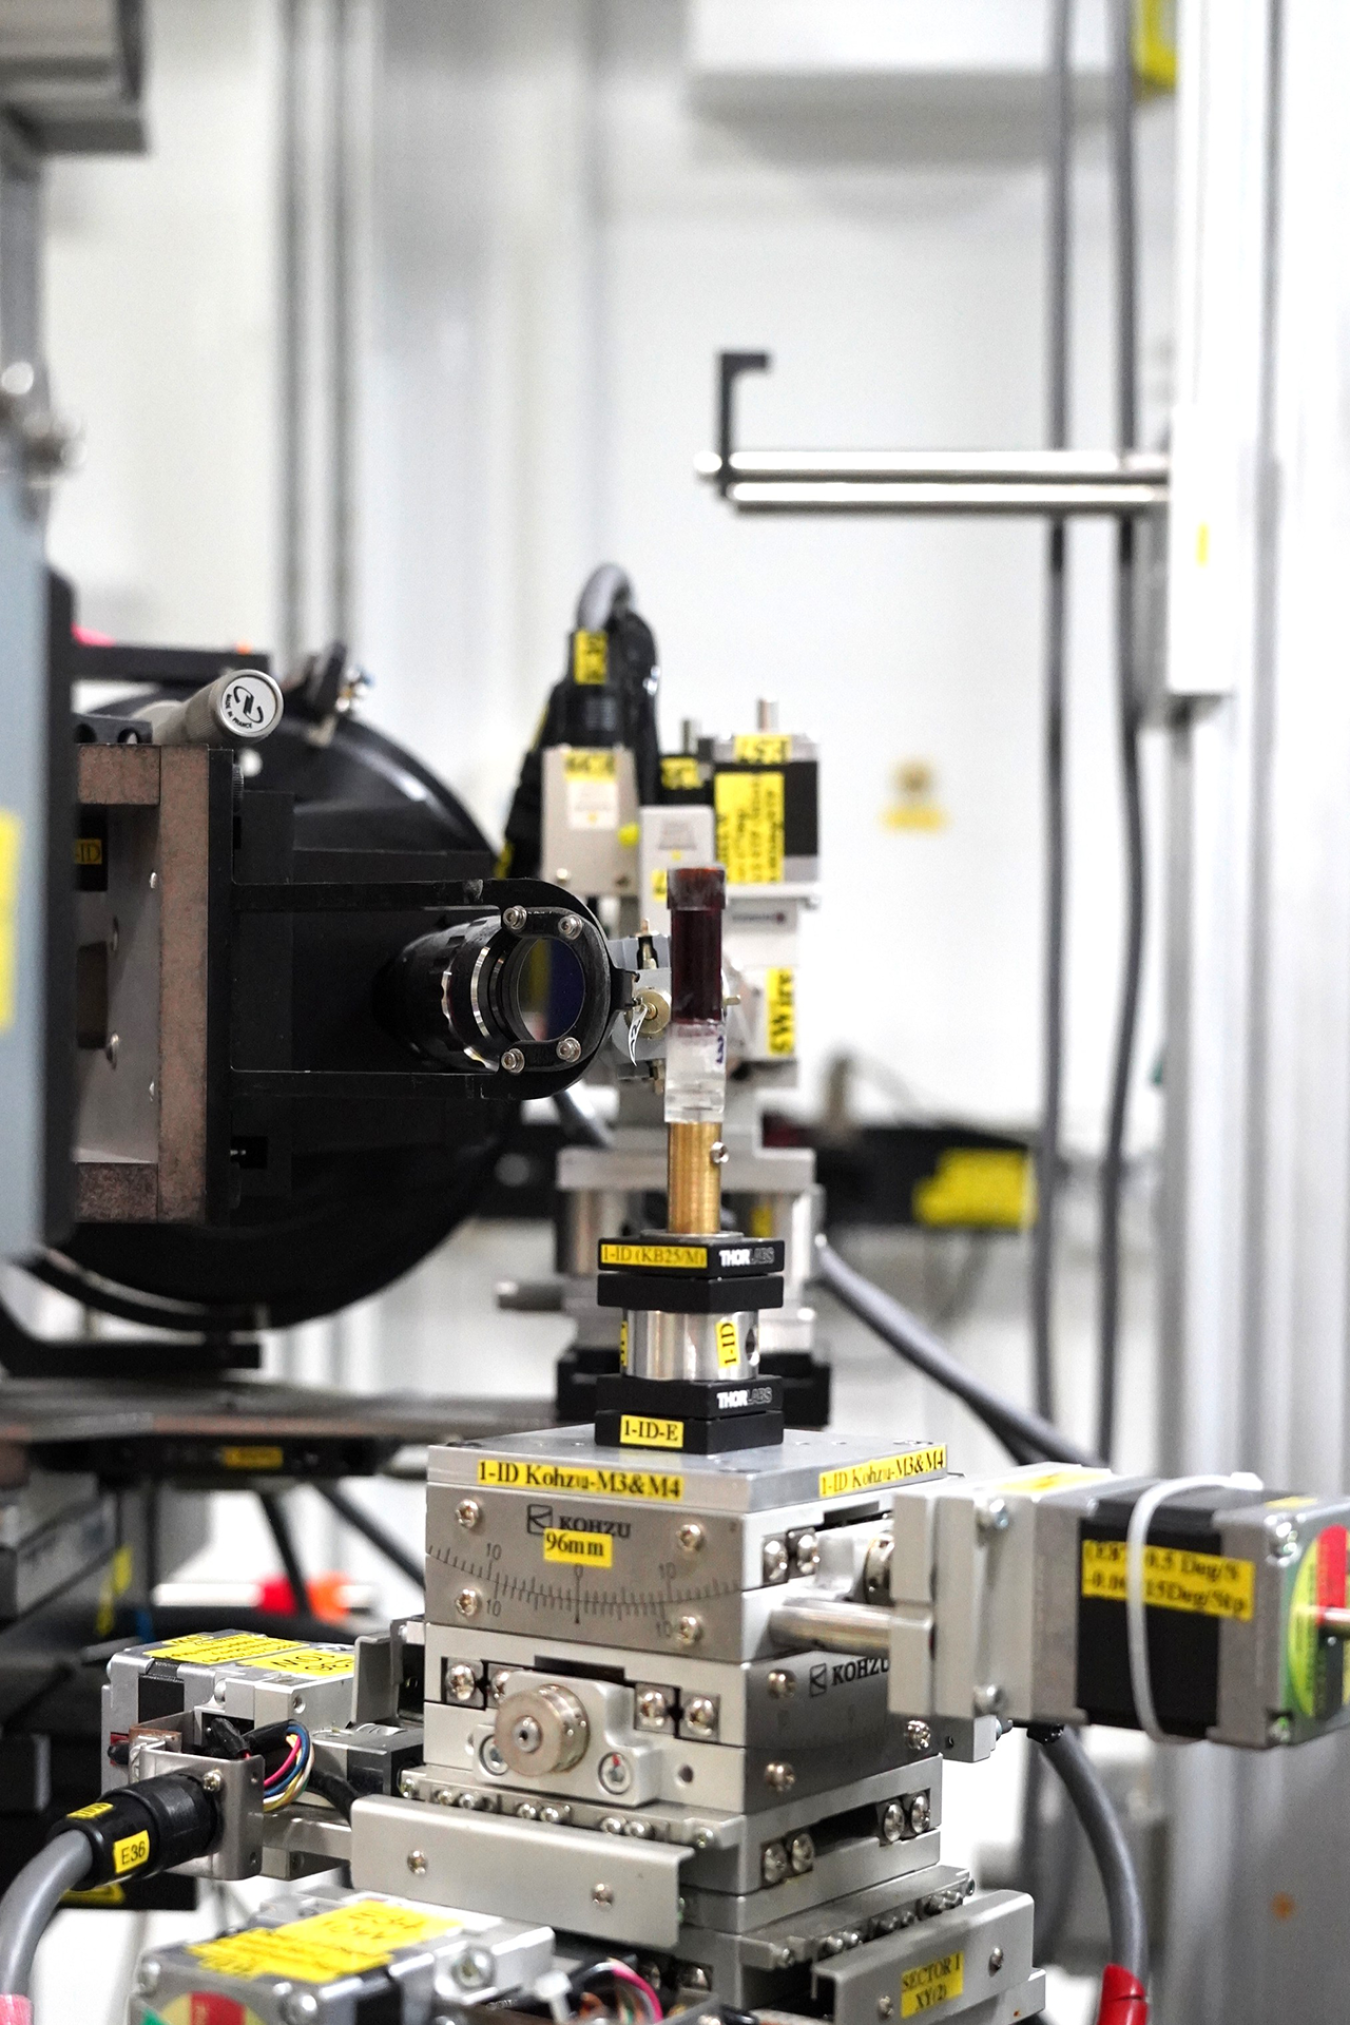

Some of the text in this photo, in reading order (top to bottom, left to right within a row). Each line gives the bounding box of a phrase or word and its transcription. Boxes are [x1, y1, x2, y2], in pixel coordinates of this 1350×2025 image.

[718, 1247, 775, 1267] THORLABS
[720, 1322, 737, 1365] 1-ID
[716, 1386, 773, 1408] THORLABS
[624, 1419, 679, 1441] 1-ID-E
[479, 1461, 519, 1483] 1-ID
[822, 1471, 848, 1495] 1-ID
[558, 1515, 632, 1538] KOHZU
[487, 1542, 502, 1561] 10
[545, 1533, 604, 1556] 96mm
[658, 1562, 676, 1580] 10
[487, 1599, 502, 1617] 10
[121, 1841, 146, 1865] E36
[901, 1956, 952, 1993] SECTOR
